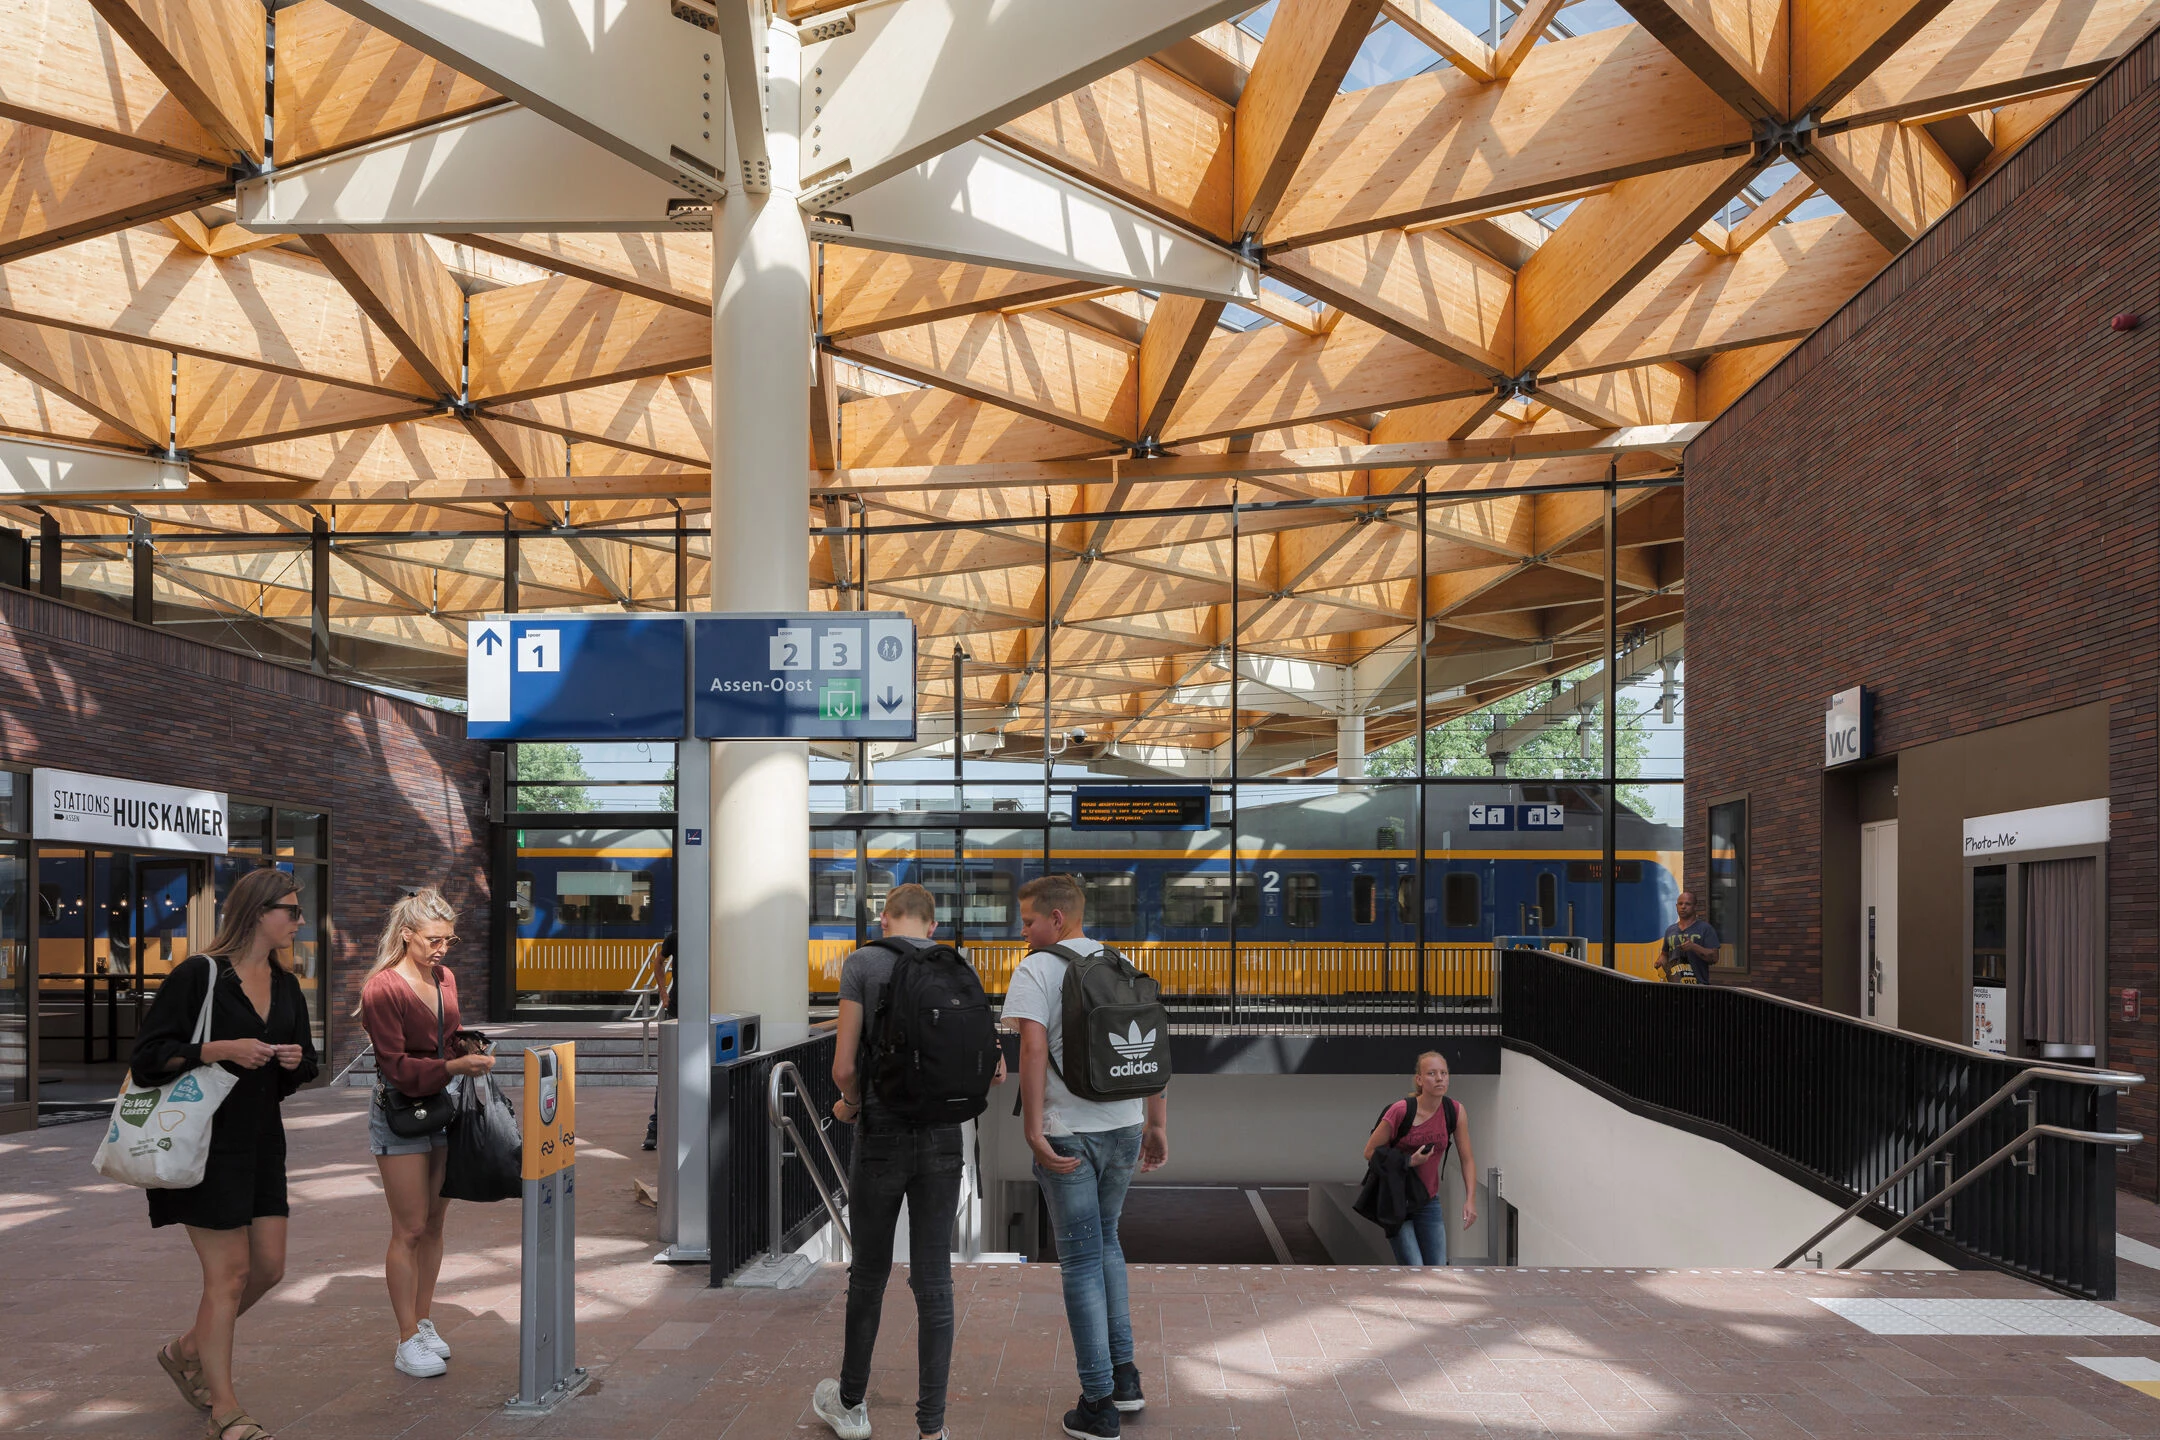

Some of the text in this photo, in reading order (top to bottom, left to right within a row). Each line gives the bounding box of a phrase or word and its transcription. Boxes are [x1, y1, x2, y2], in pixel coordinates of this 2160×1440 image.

[532, 645, 543, 668] 1
[783, 643, 799, 667] 2
[832, 643, 848, 667] 3
[710, 677, 813, 692] Assen-Oost
[1829, 726, 1857, 759] WC
[54, 789, 223, 837] STATIONS HUISKAMER
[65, 815, 80, 823] ASSEN
[1493, 814, 1499, 823] 1
[1965, 833, 2017, 851] Photo-Me
[1262, 870, 1281, 893] 2
[1109, 1060, 1159, 1077] adidas
